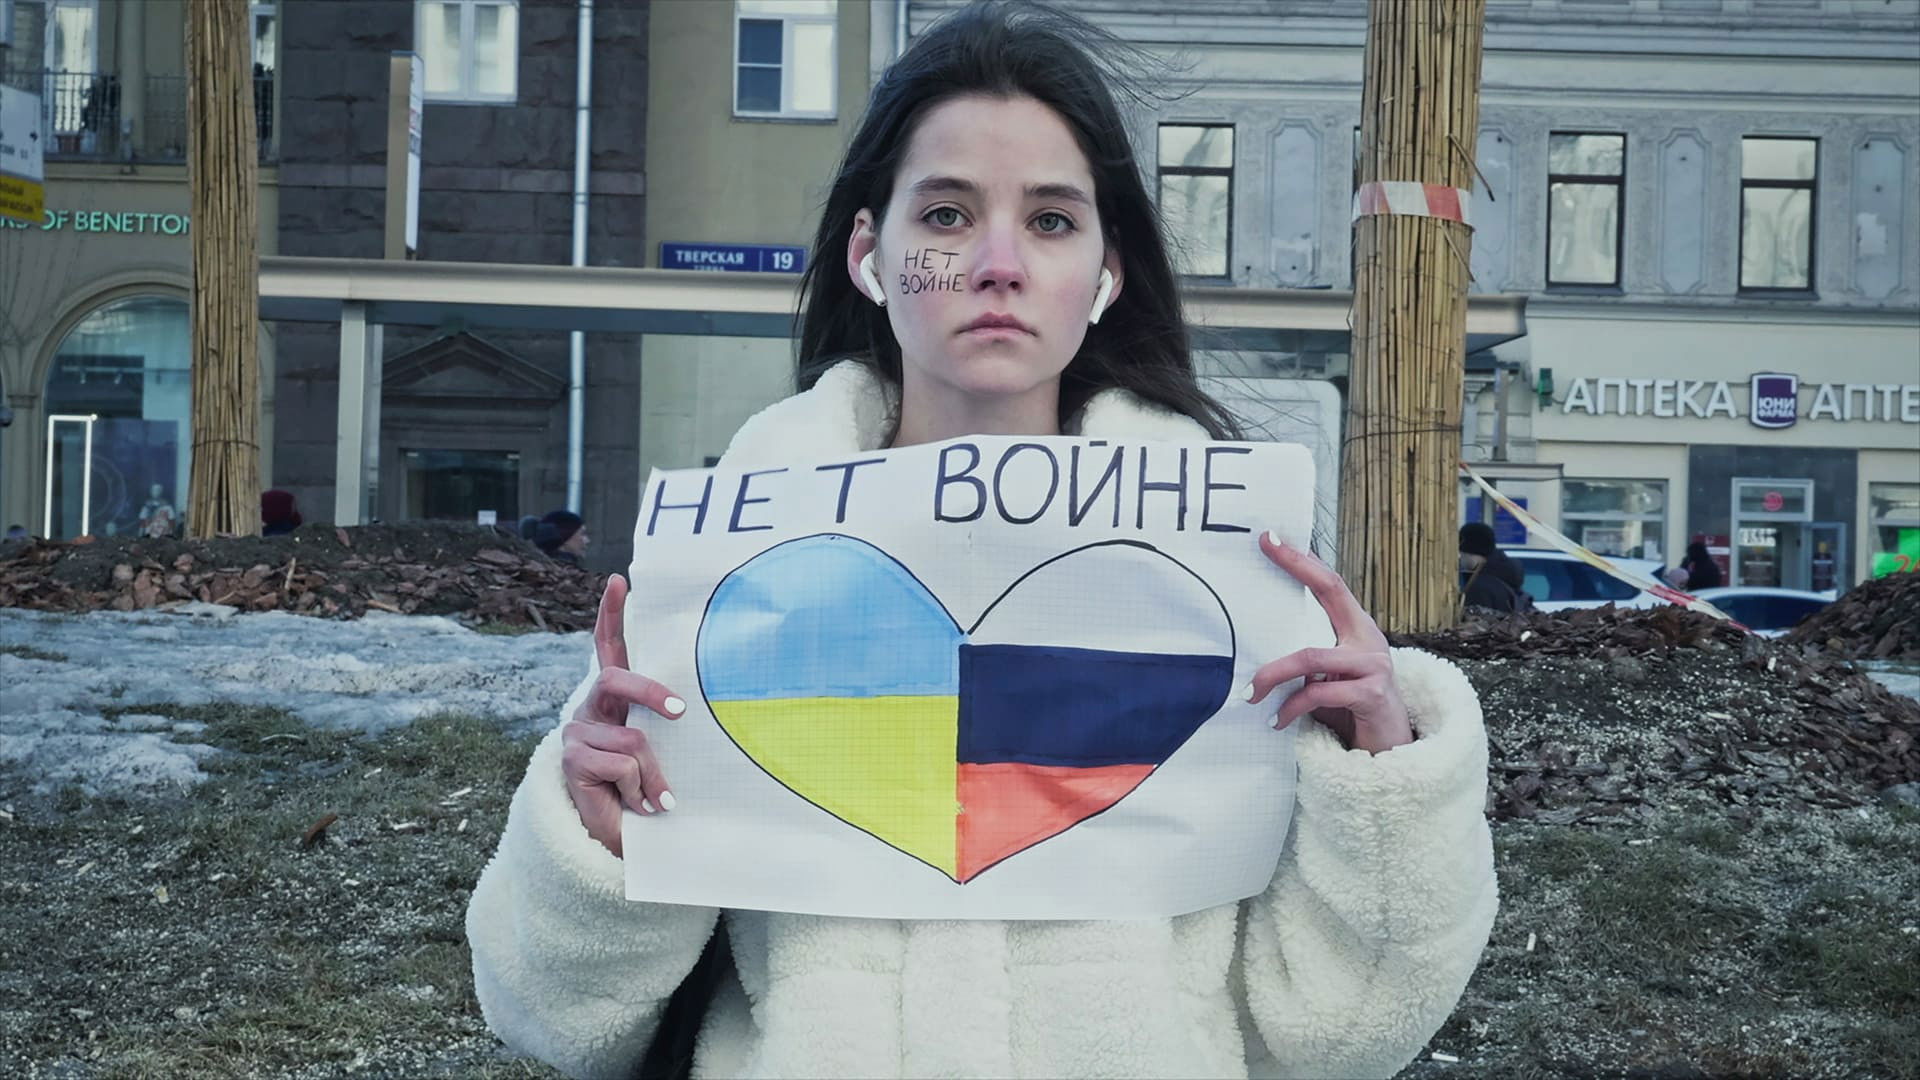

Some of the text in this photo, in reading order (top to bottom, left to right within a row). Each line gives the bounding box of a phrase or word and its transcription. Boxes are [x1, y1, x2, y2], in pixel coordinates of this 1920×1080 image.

[676, 250, 794, 270] ТВЕРСКАЯ 19
[904, 248, 960, 270] НЕТ
[899, 270, 966, 295] ВОЙНЕ
[1563, 377, 1738, 418] АПТЕКА
[1758, 397, 1795, 409] ЮНИ
[646, 440, 1254, 536] НЕТ ВОЙНЕ
